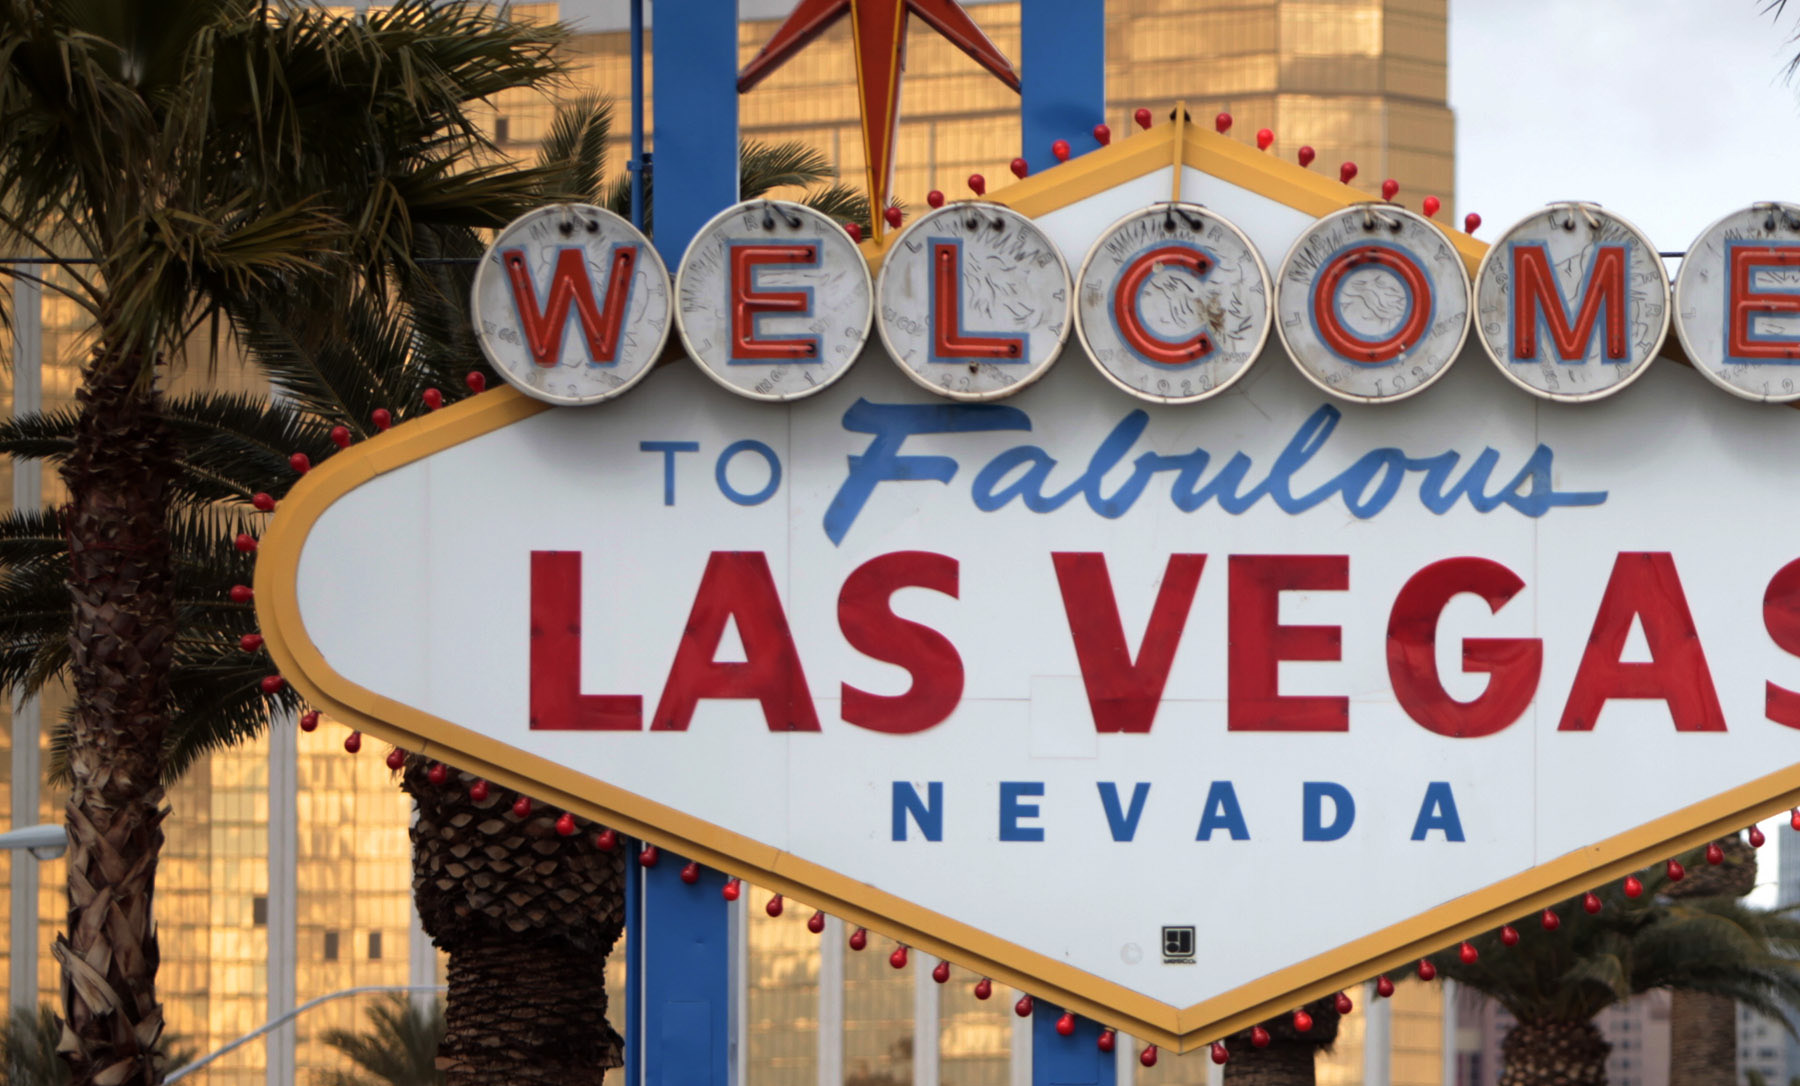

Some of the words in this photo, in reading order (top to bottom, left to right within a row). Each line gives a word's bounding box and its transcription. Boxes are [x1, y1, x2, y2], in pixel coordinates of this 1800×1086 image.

[641, 440, 781, 506] TO
[822, 398, 1610, 547] Fabulous
[529, 550, 965, 735] LAS
[891, 779, 1467, 843] NEVADA
